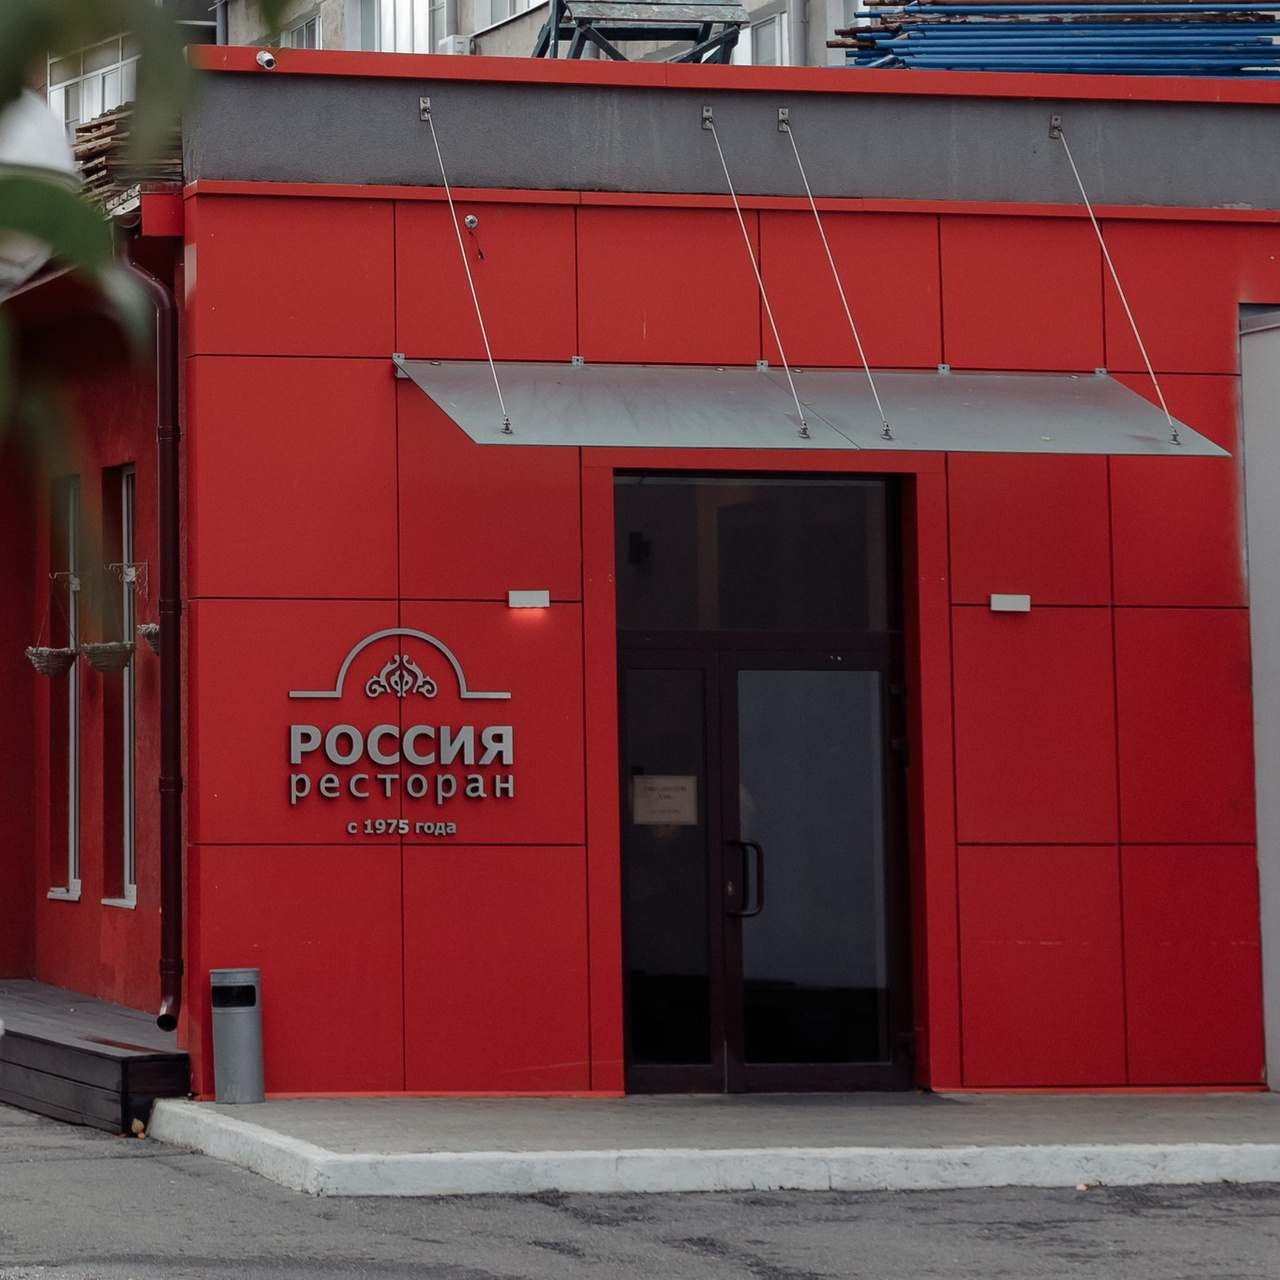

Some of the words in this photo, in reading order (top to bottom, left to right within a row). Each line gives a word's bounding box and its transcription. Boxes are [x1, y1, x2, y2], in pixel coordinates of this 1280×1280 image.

[289, 724, 514, 765] РОССИЯ
[289, 773, 514, 805] ресторан
[347, 822, 358, 835] с
[363, 819, 410, 835] 1975
[414, 822, 457, 836] года
